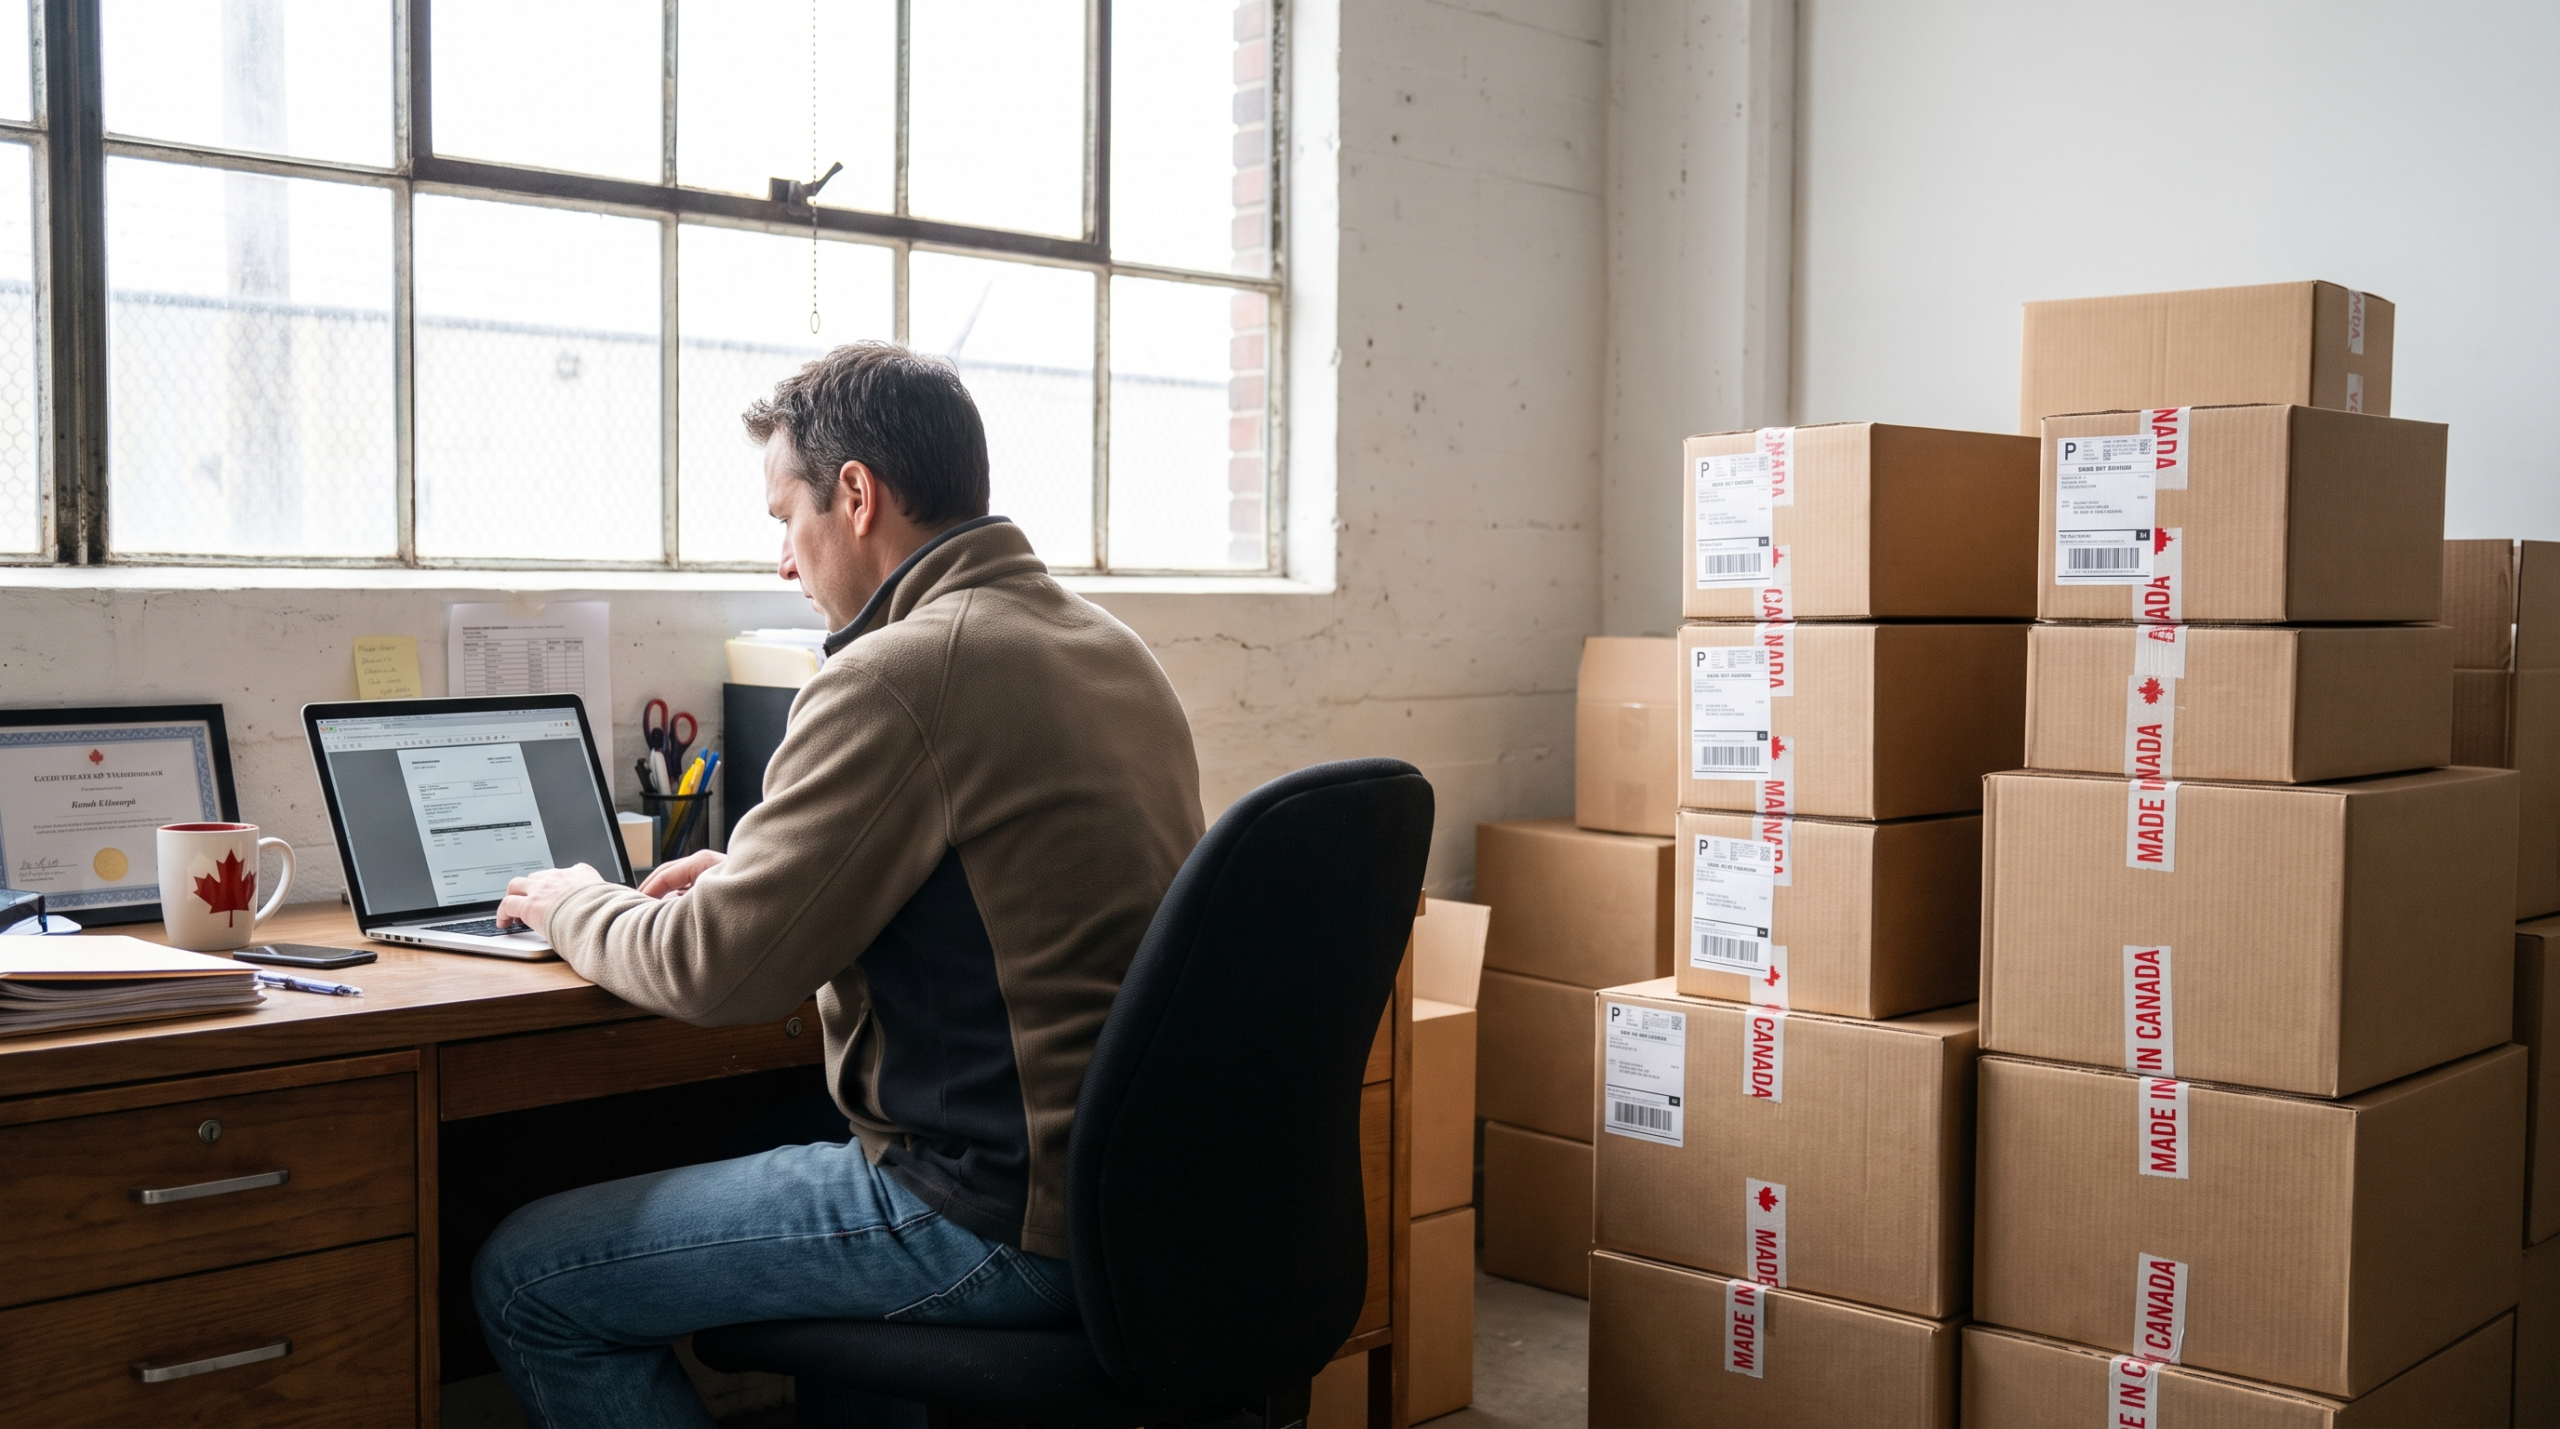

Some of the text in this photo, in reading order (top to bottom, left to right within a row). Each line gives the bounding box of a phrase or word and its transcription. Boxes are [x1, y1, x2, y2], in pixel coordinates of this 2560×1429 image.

[1700, 461, 1710, 478] P
[2064, 442, 2077, 461] P
[1696, 652, 1706, 667] P
[1699, 839, 1709, 855] P
[2137, 798, 2165, 863] MADE
[1611, 1007, 1621, 1022] P
[2134, 950, 2163, 1071] IN CANADA
[1752, 1017, 1775, 1099] CANADA
[2150, 1079, 2178, 1173] MADE IN
[1733, 1284, 1756, 1370] MADE IN
[2145, 1261, 2176, 1350] CANADA
[2119, 1383, 2147, 1410] IN
